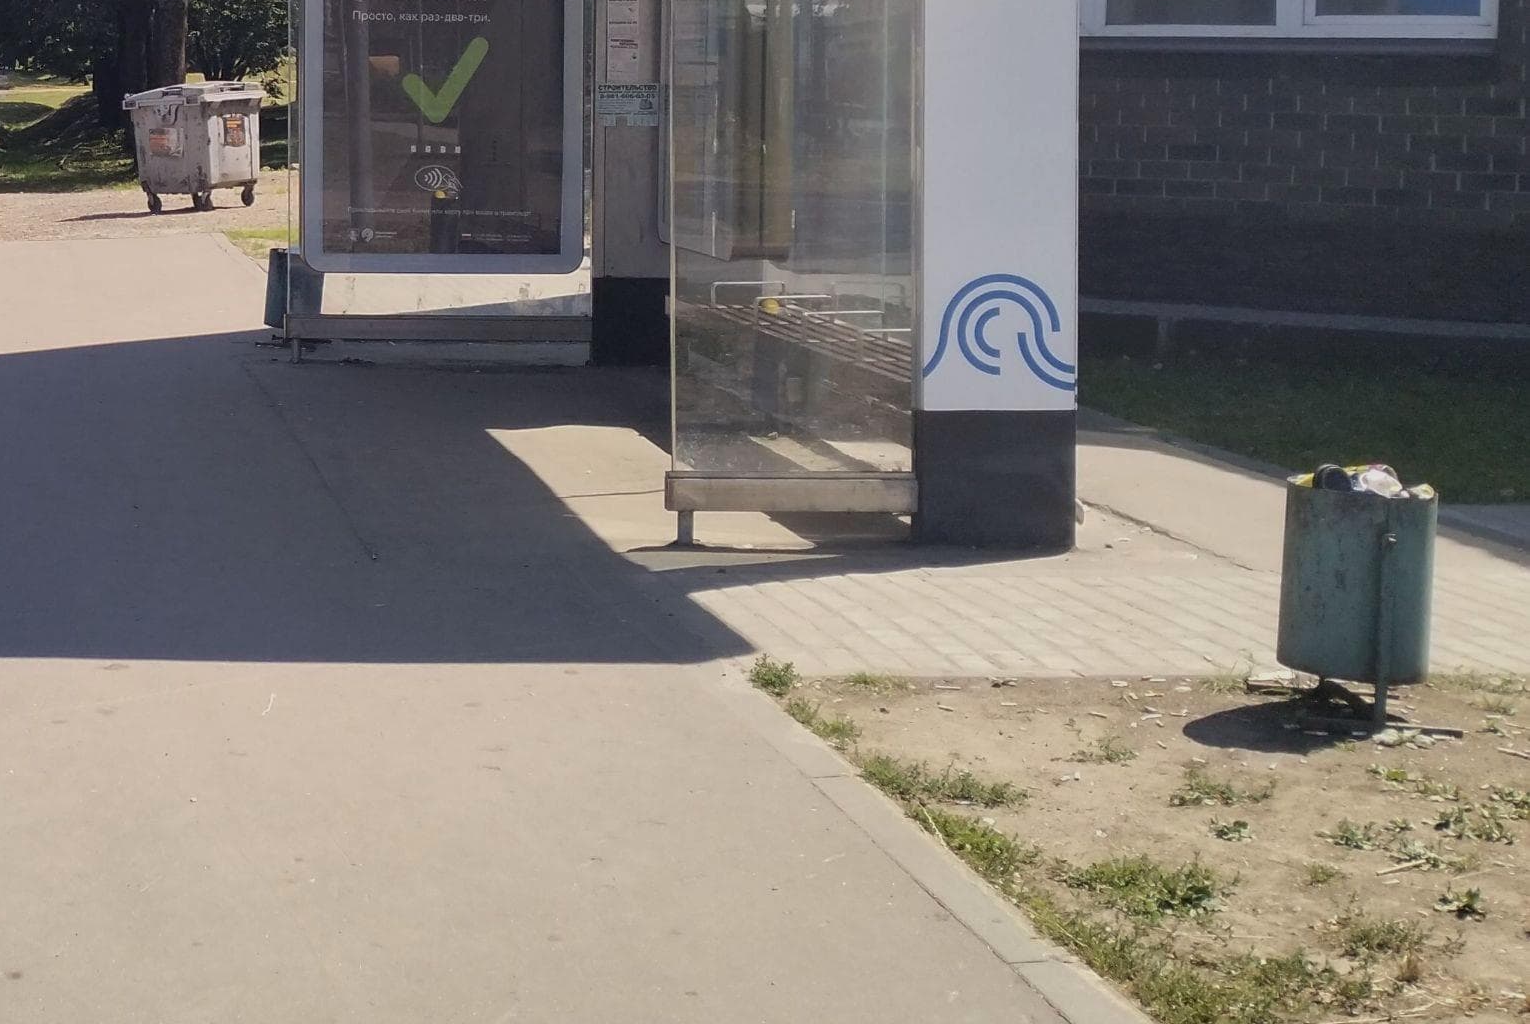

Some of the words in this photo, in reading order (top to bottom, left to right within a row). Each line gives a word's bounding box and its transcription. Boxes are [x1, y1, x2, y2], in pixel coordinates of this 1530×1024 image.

[352, 10, 396, 22] Просто,
[399, 13, 418, 21] как
[420, 12, 491, 23] раз-два-три.
